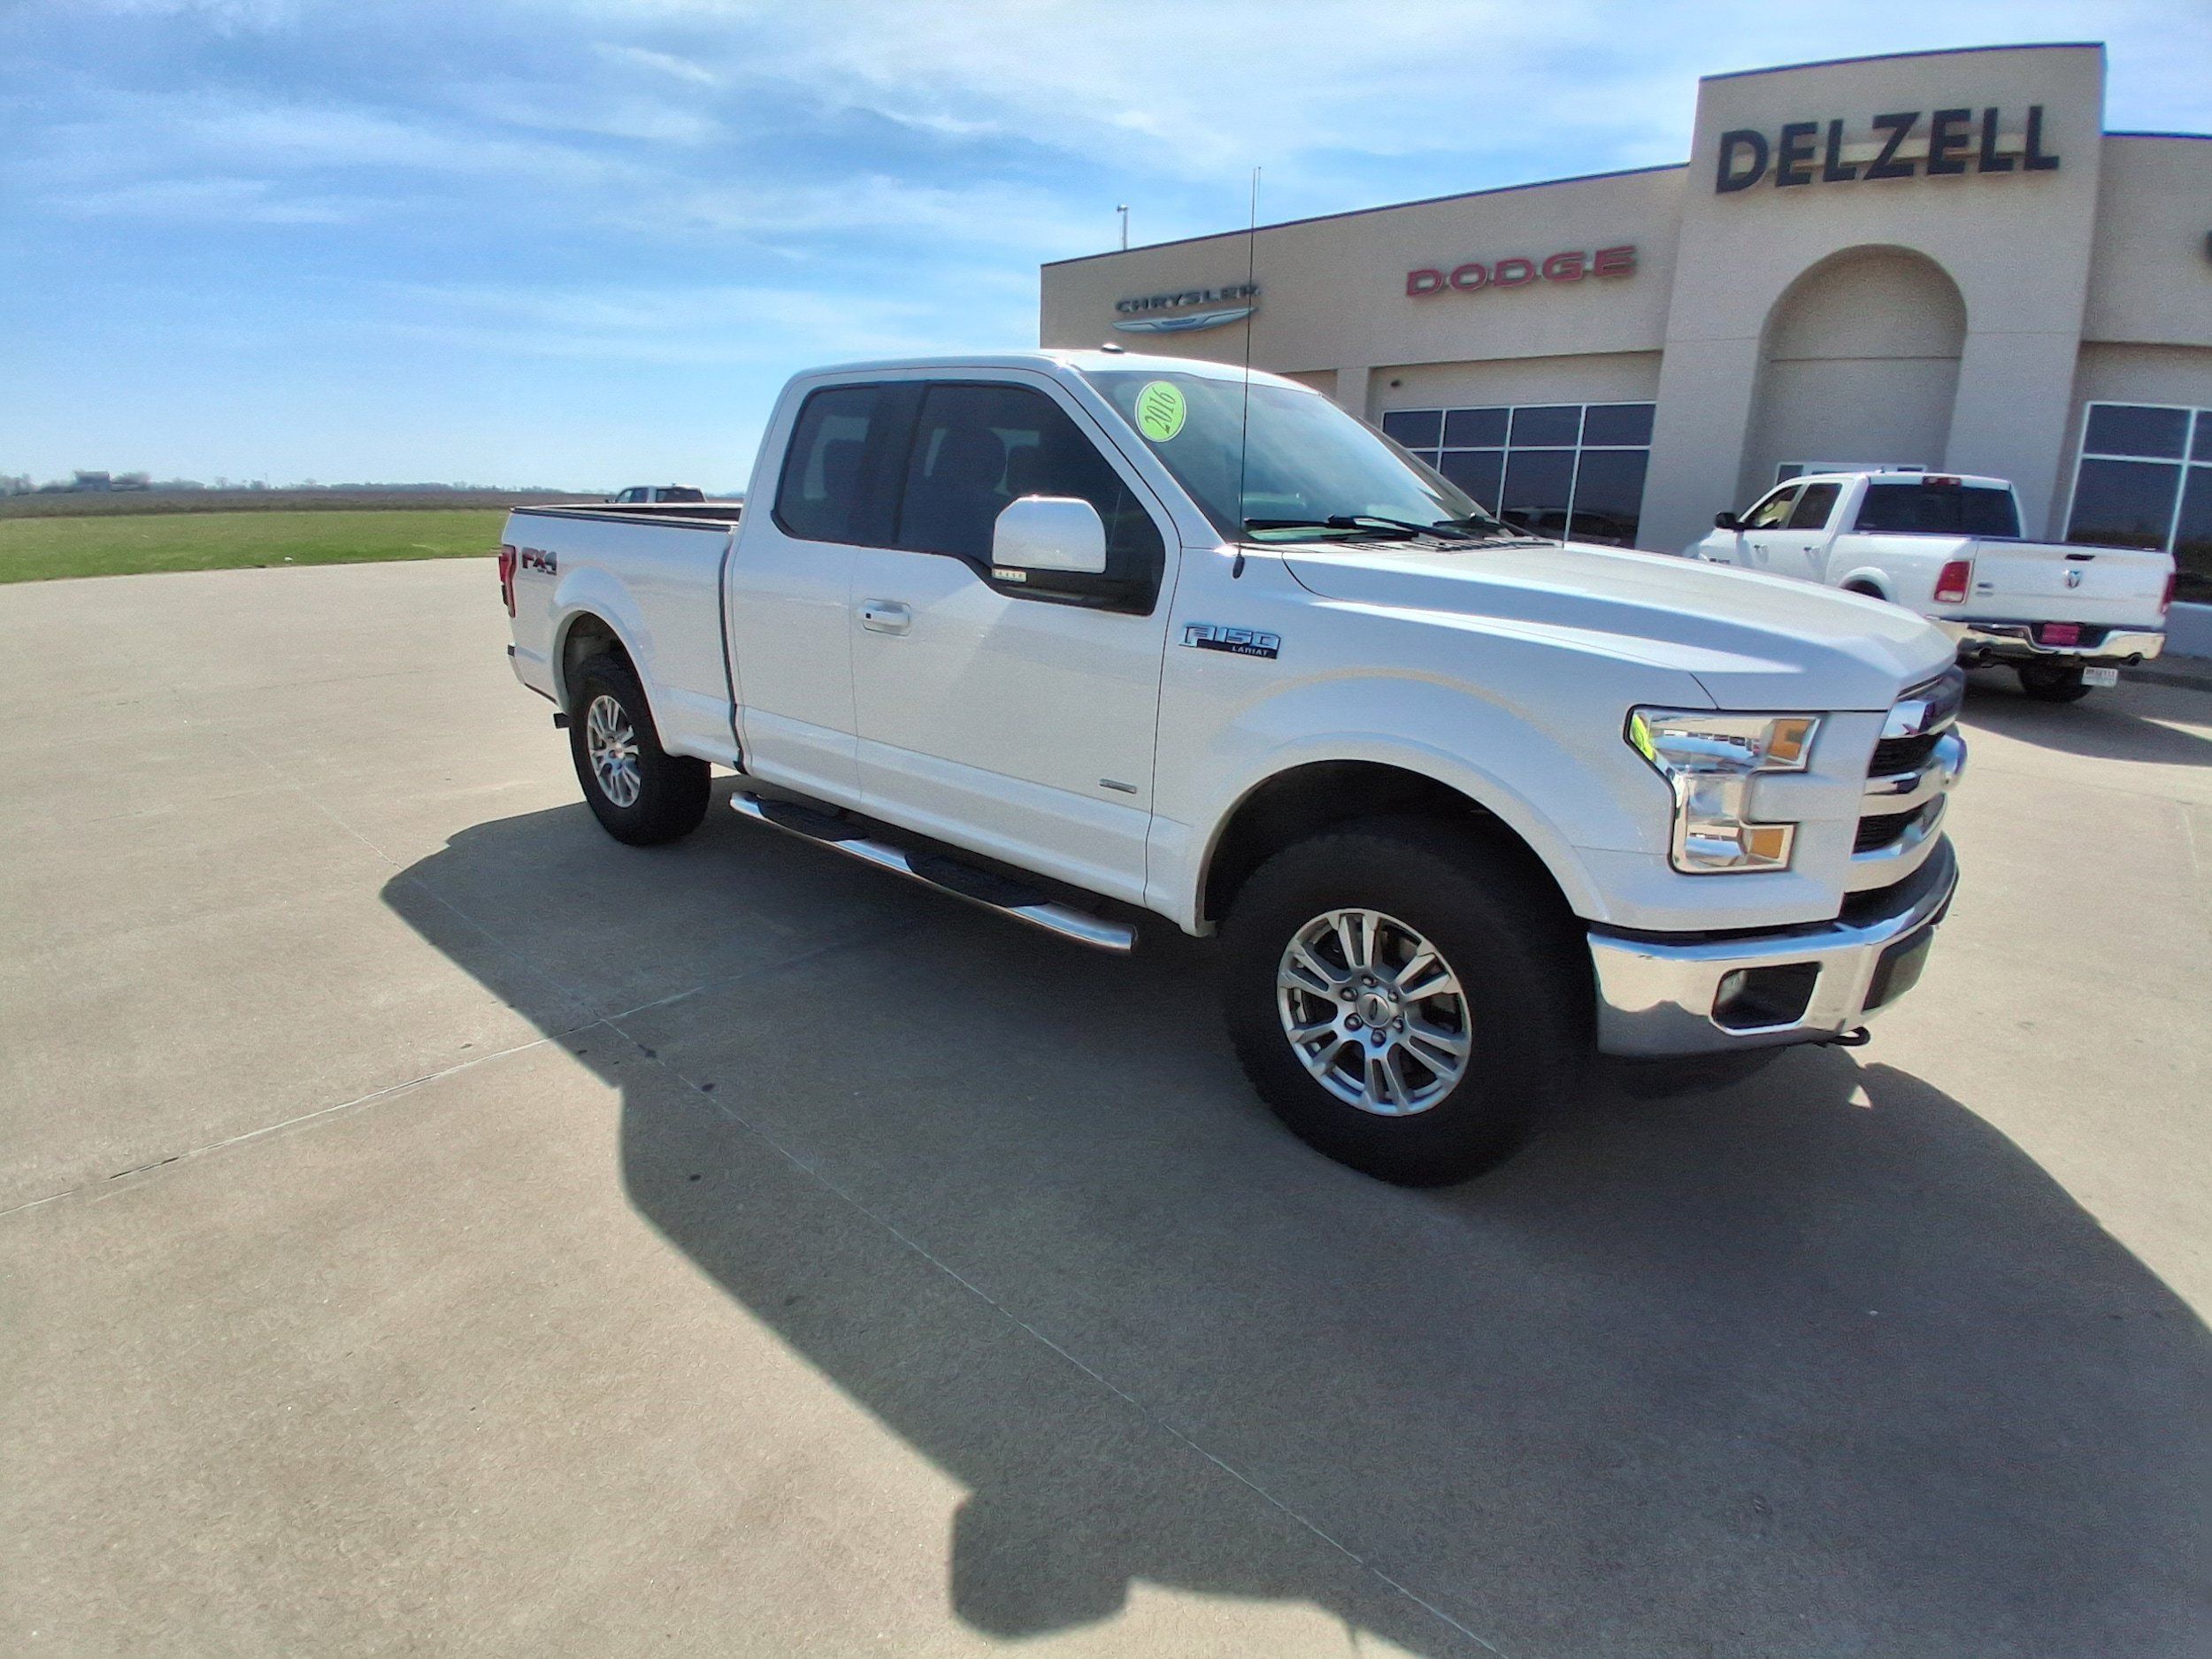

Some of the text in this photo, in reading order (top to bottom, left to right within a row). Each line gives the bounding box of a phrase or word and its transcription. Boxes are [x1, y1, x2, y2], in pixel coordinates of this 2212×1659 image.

[1715, 104, 2061, 195] DELZELL
[1406, 244, 1637, 297] DODGE
[1144, 387, 1176, 434] 2016
[520, 546, 557, 571] FX4
